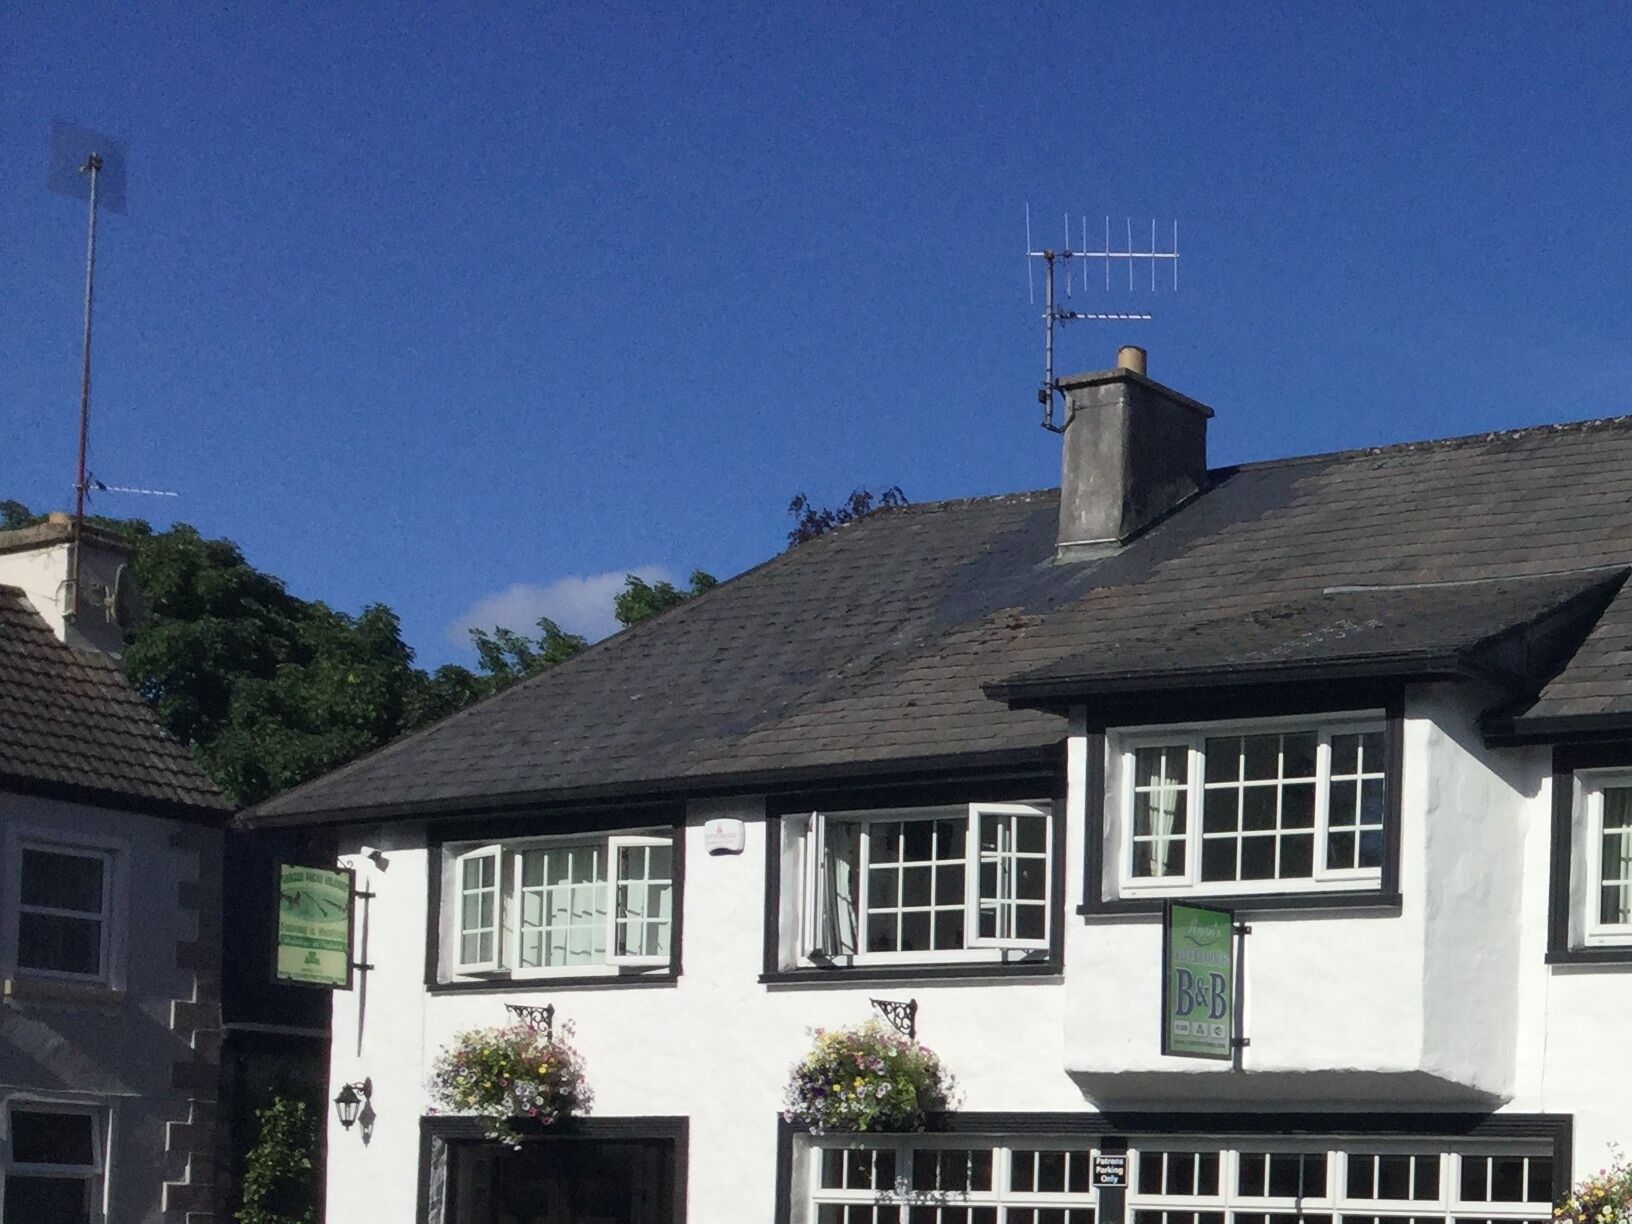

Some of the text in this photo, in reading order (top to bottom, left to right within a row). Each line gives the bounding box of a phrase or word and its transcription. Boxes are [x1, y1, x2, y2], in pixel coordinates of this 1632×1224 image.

[1175, 967, 1227, 1020] B&B
[1096, 1157, 1123, 1165] Patrons
[1096, 1166, 1123, 1175] Parking
[1100, 1175, 1118, 1184] Only
